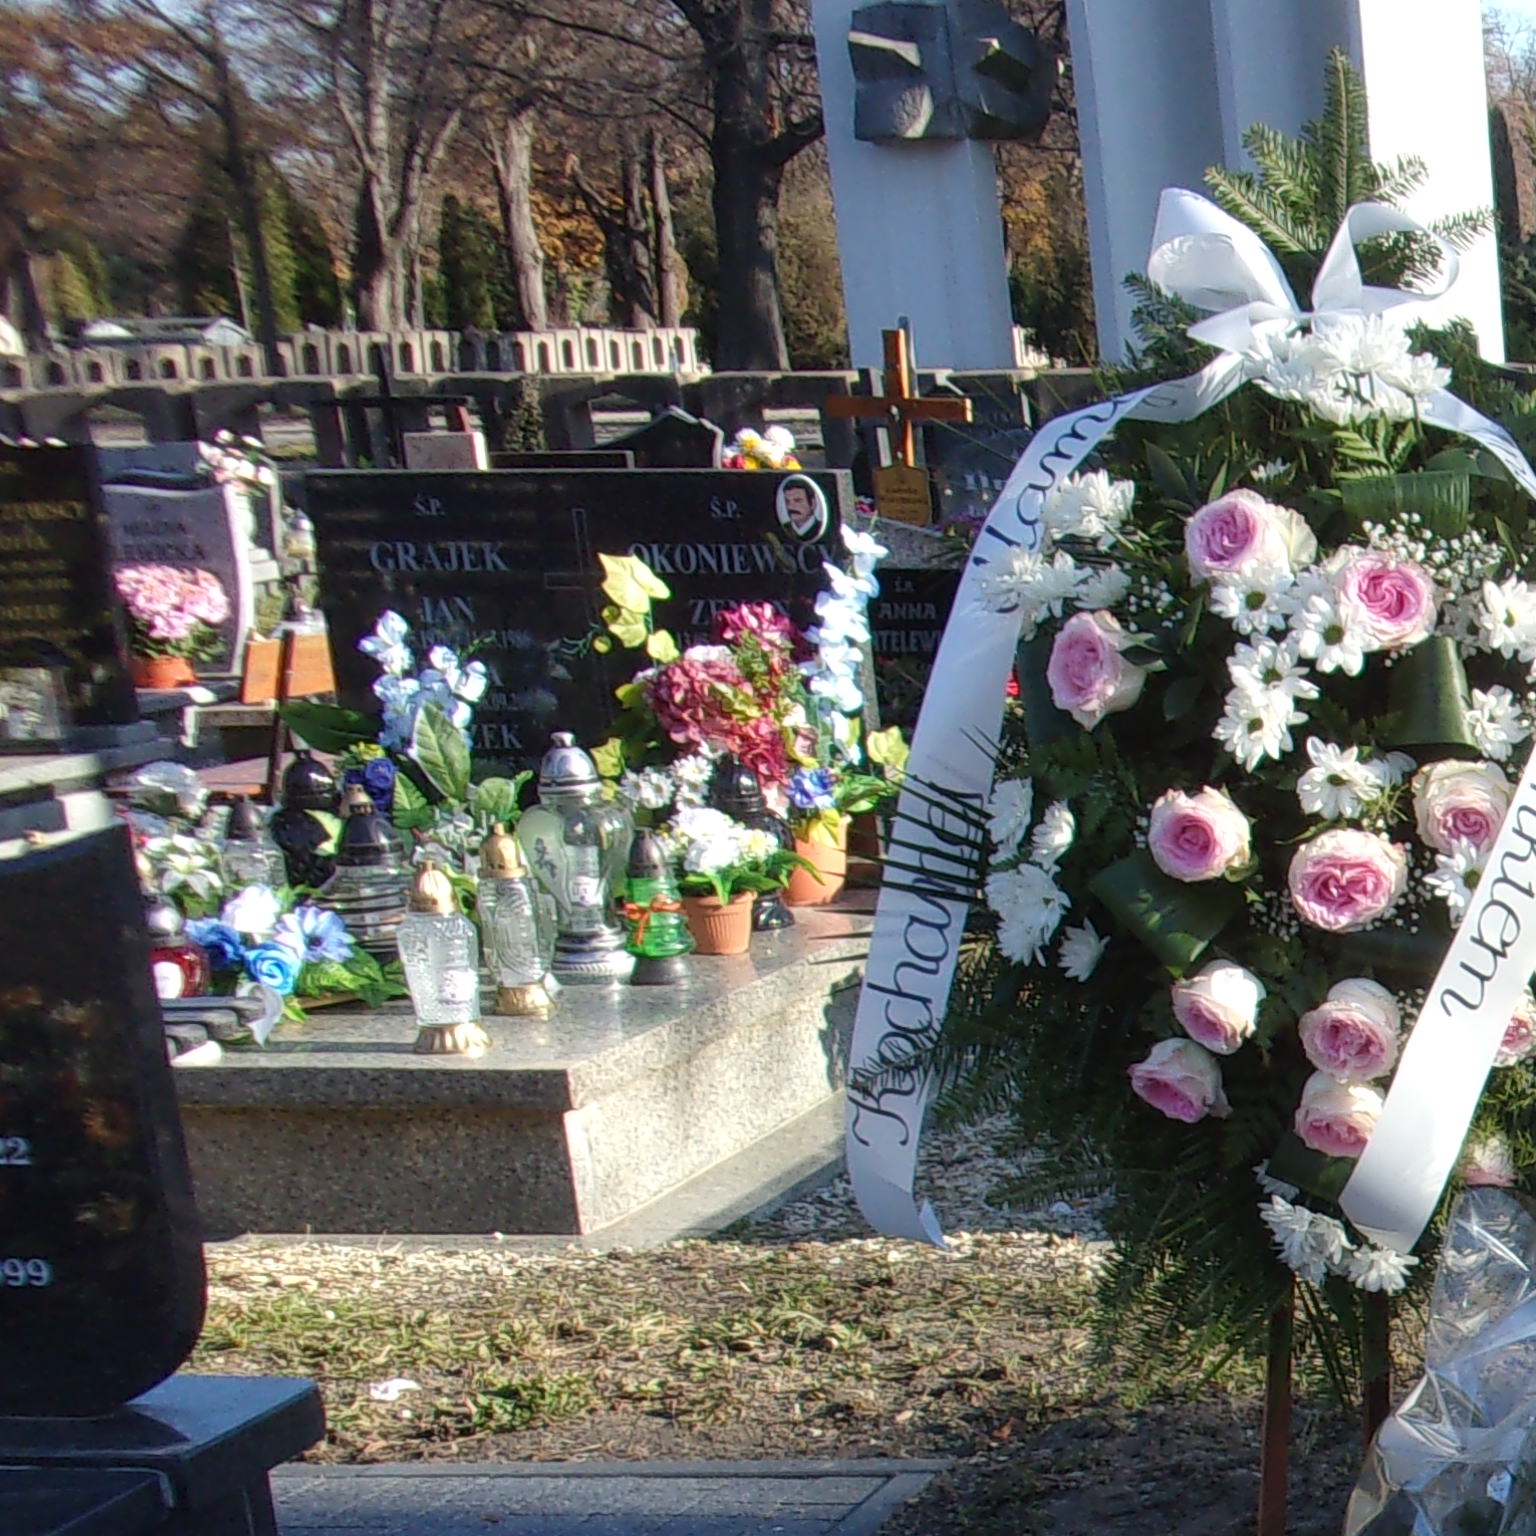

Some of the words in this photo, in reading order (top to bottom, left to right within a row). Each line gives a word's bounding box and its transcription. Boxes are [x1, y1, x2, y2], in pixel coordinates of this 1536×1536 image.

[369, 540, 511, 573] GRAJEK
[420, 596, 475, 624] JAN
[878, 602, 936, 620] ANNA
